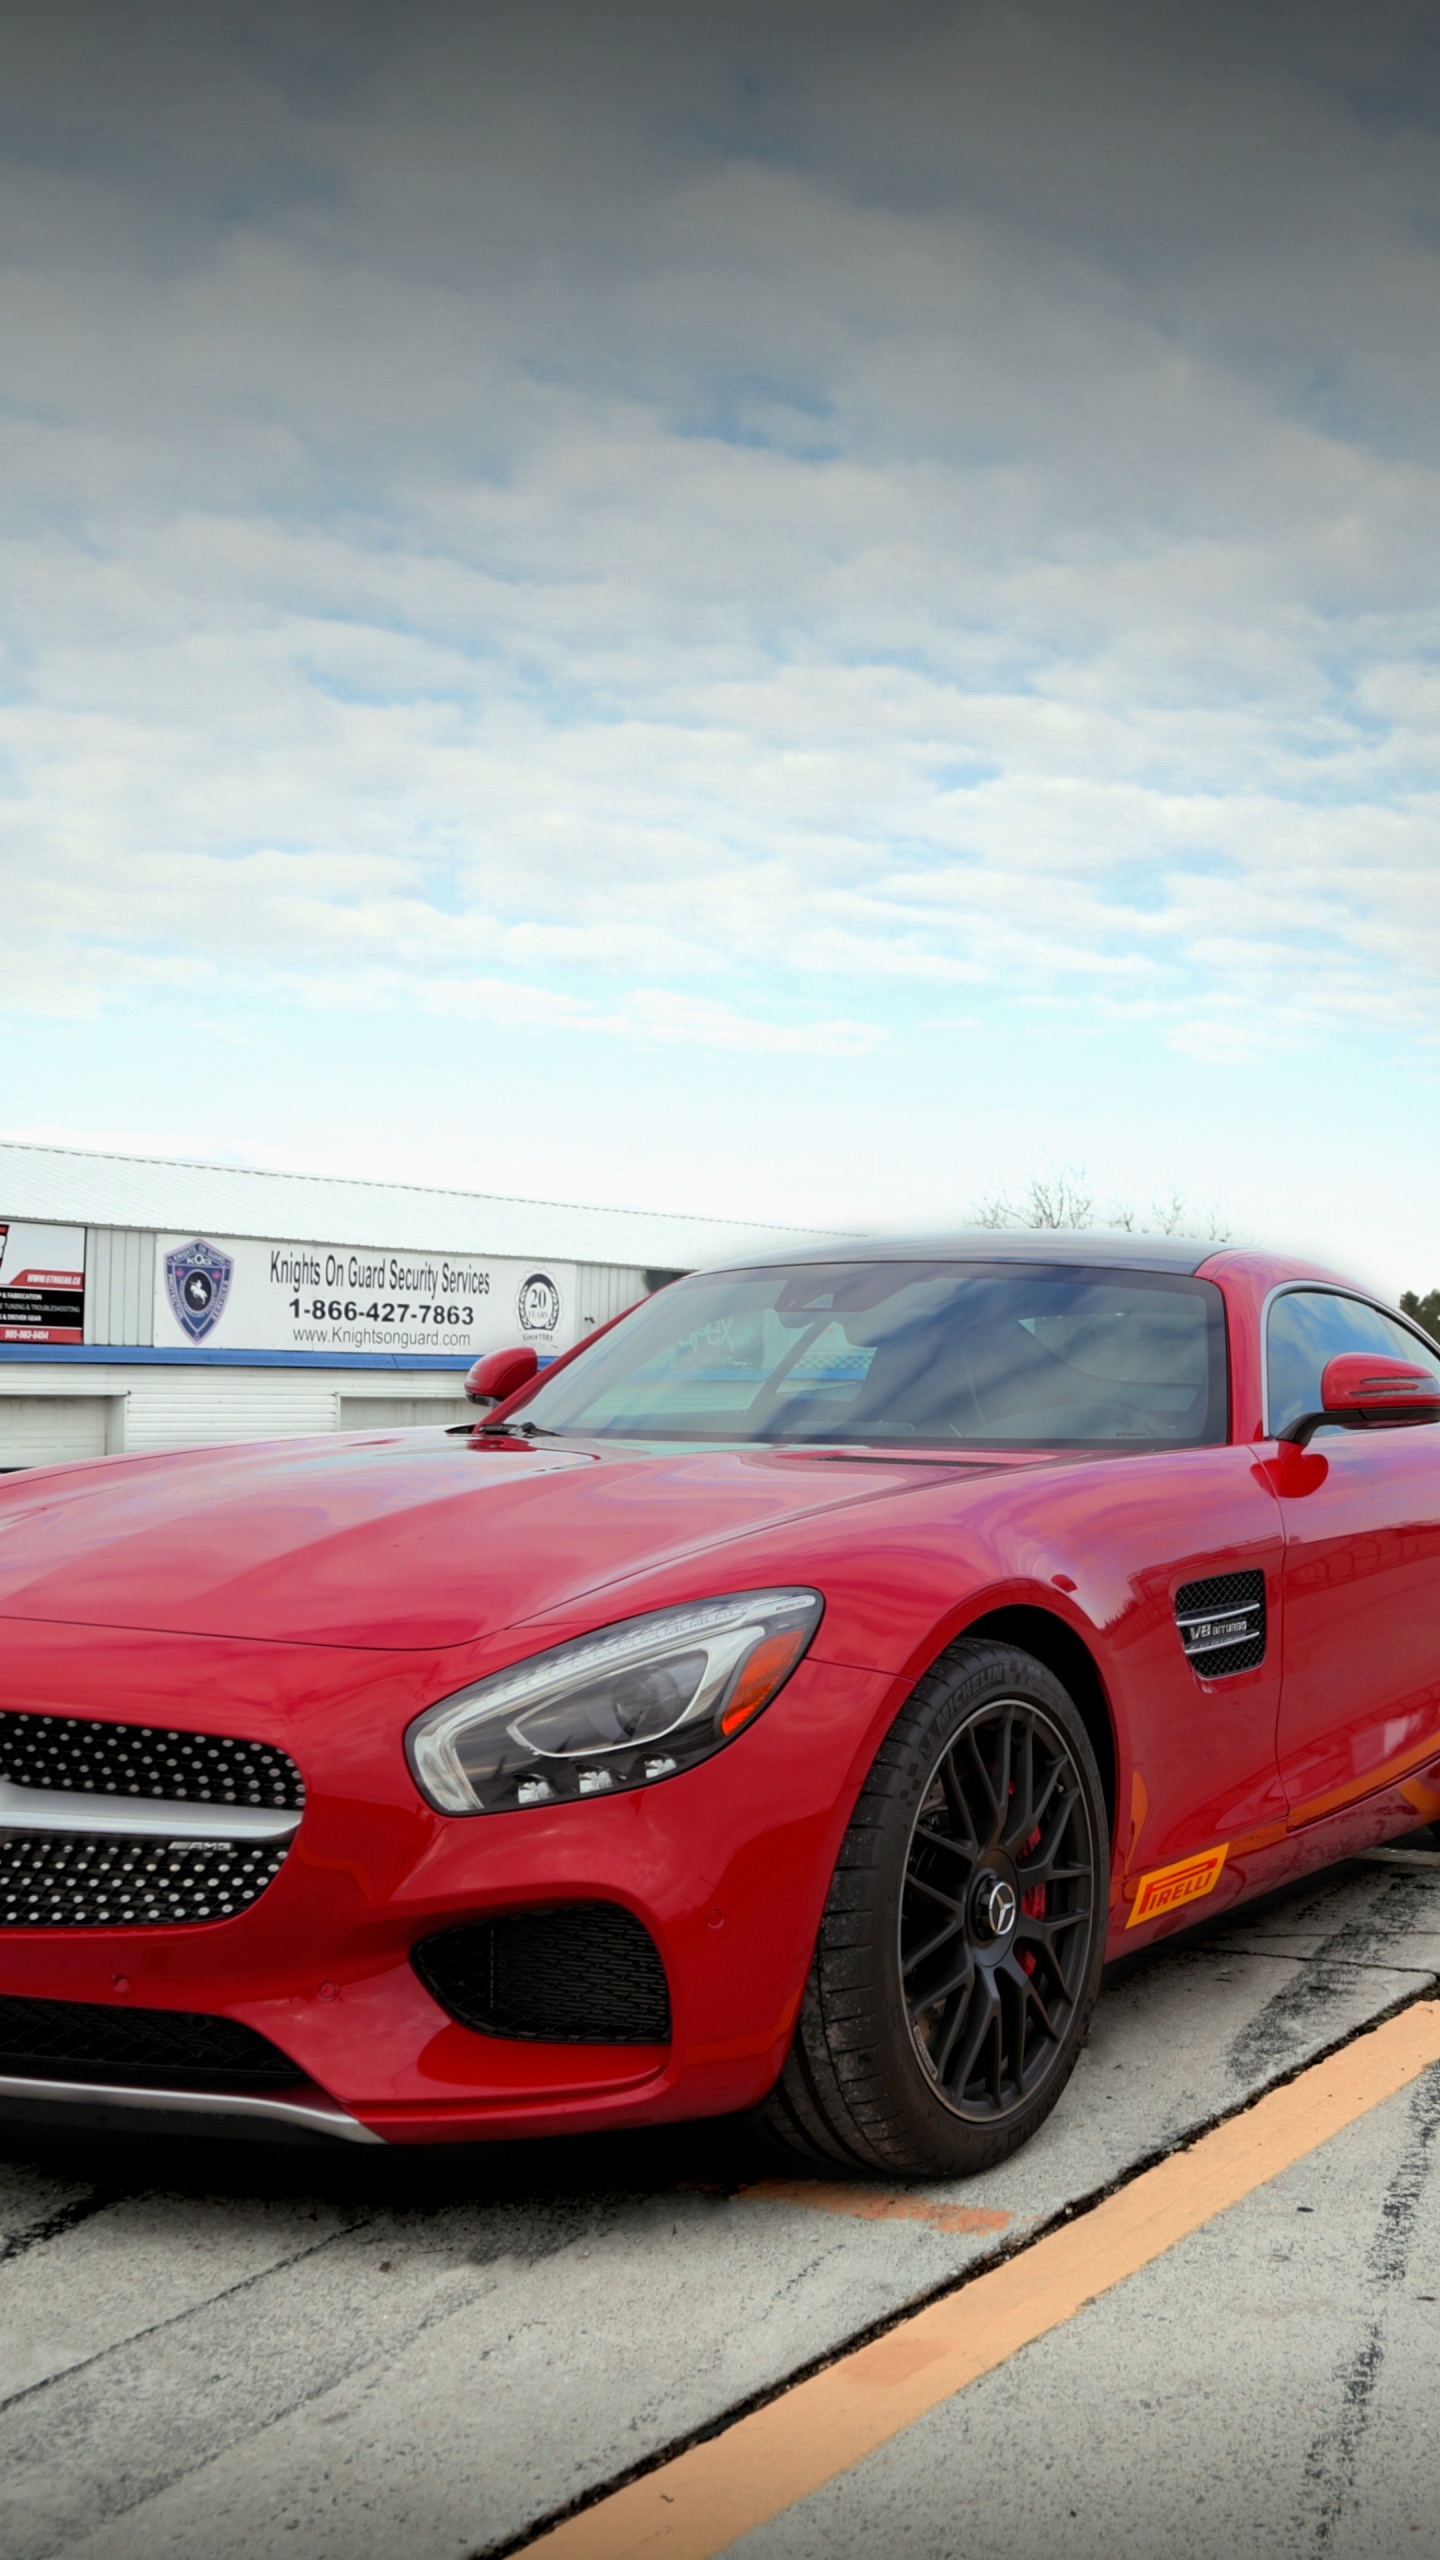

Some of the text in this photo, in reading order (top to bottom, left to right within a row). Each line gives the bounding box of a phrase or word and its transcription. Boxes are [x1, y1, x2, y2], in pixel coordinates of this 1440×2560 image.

[270, 1250, 490, 1300] Knights On Guard Security Services
[7, 1292, 42, 1300] FABRICATION
[530, 1288, 547, 1308] 20
[4, 1302, 26, 1310] TUNING
[31, 1304, 80, 1312] TROUBLESHOOTING
[289, 1297, 474, 1326] 1-866-427-7863
[528, 1310, 549, 1319] YEARS
[293, 1326, 470, 1349] www.Knightsonguard.com
[1189, 1620, 1247, 1641] V8 BITURBO
[935, 1664, 1005, 1733] MICHELIN
[188, 1842, 231, 1851] AMG
[1137, 1857, 1219, 1916] PIRELLI
